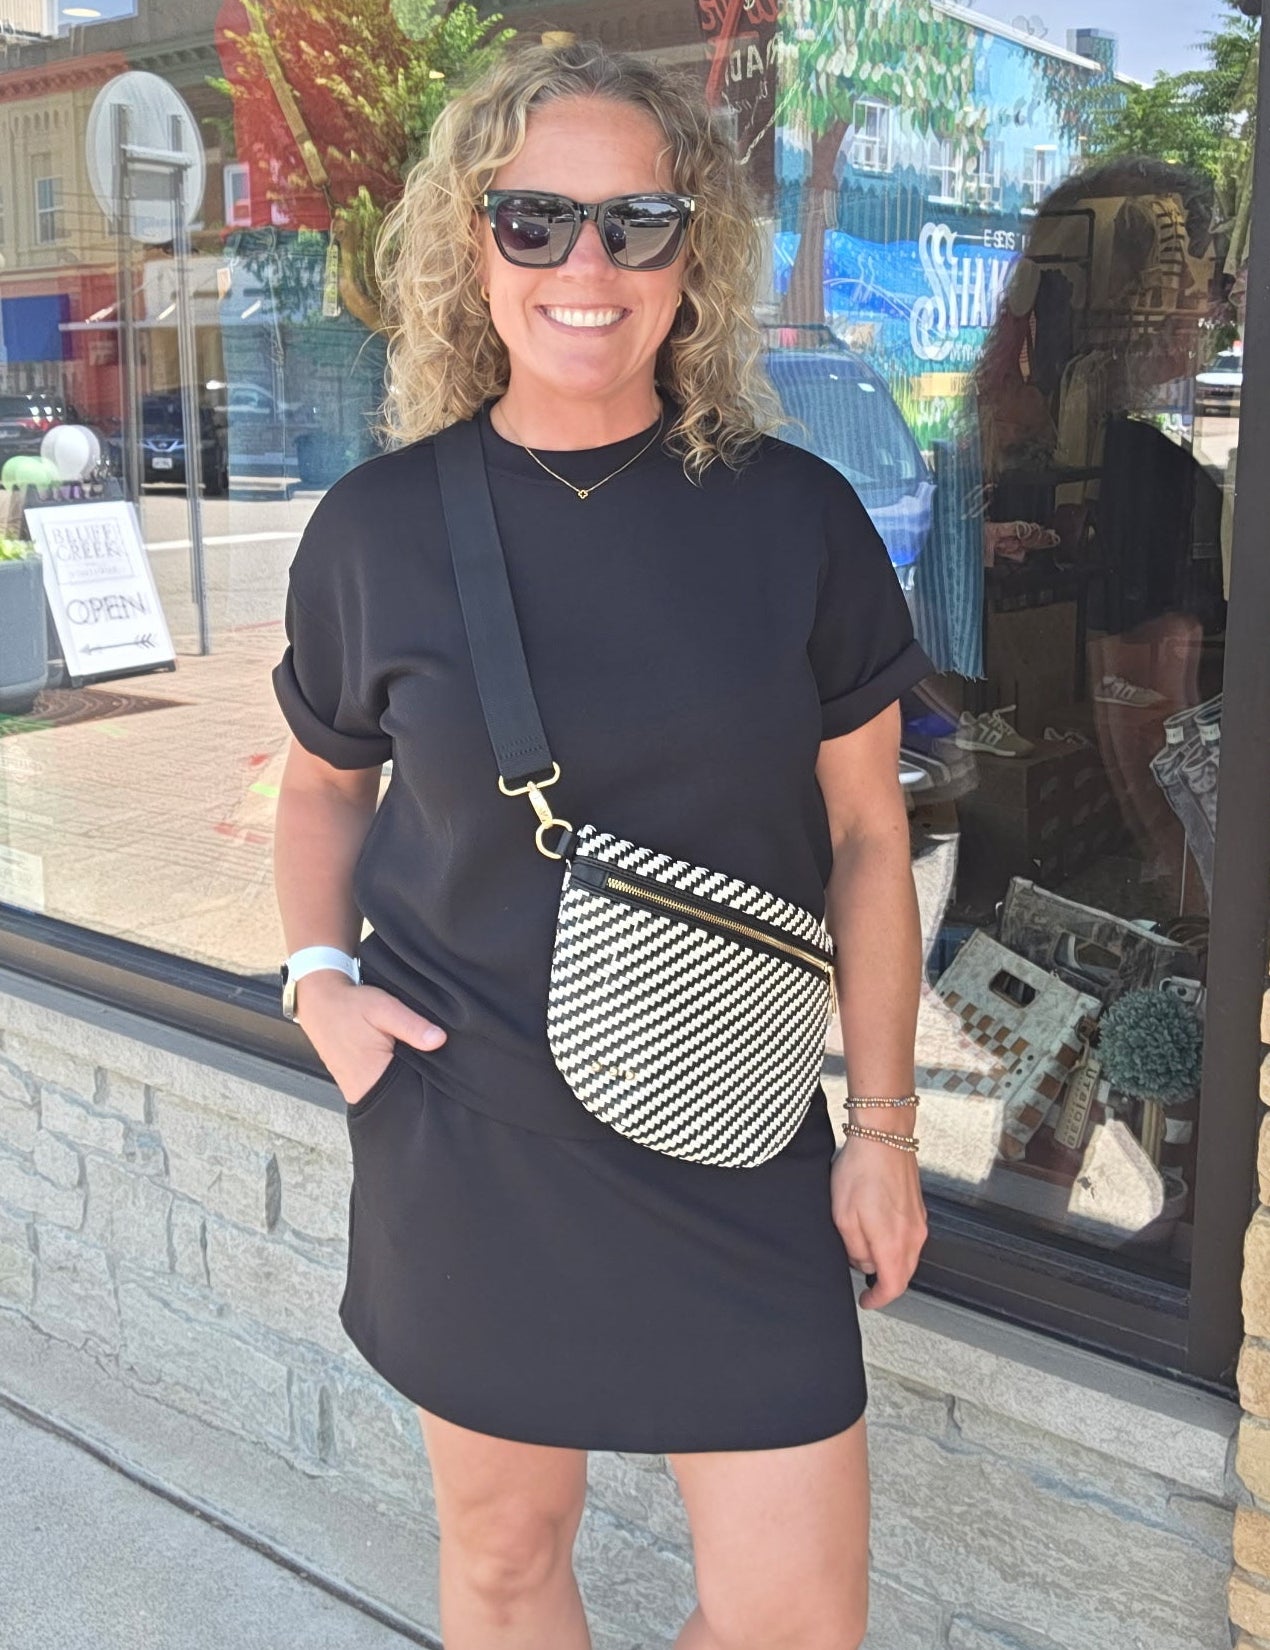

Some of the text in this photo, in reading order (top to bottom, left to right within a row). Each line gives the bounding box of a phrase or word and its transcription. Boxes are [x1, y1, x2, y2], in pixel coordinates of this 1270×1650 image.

[51, 522, 118, 545] BLUFF
[55, 541, 123, 562] CREEK
[65, 591, 148, 625] OPEN
